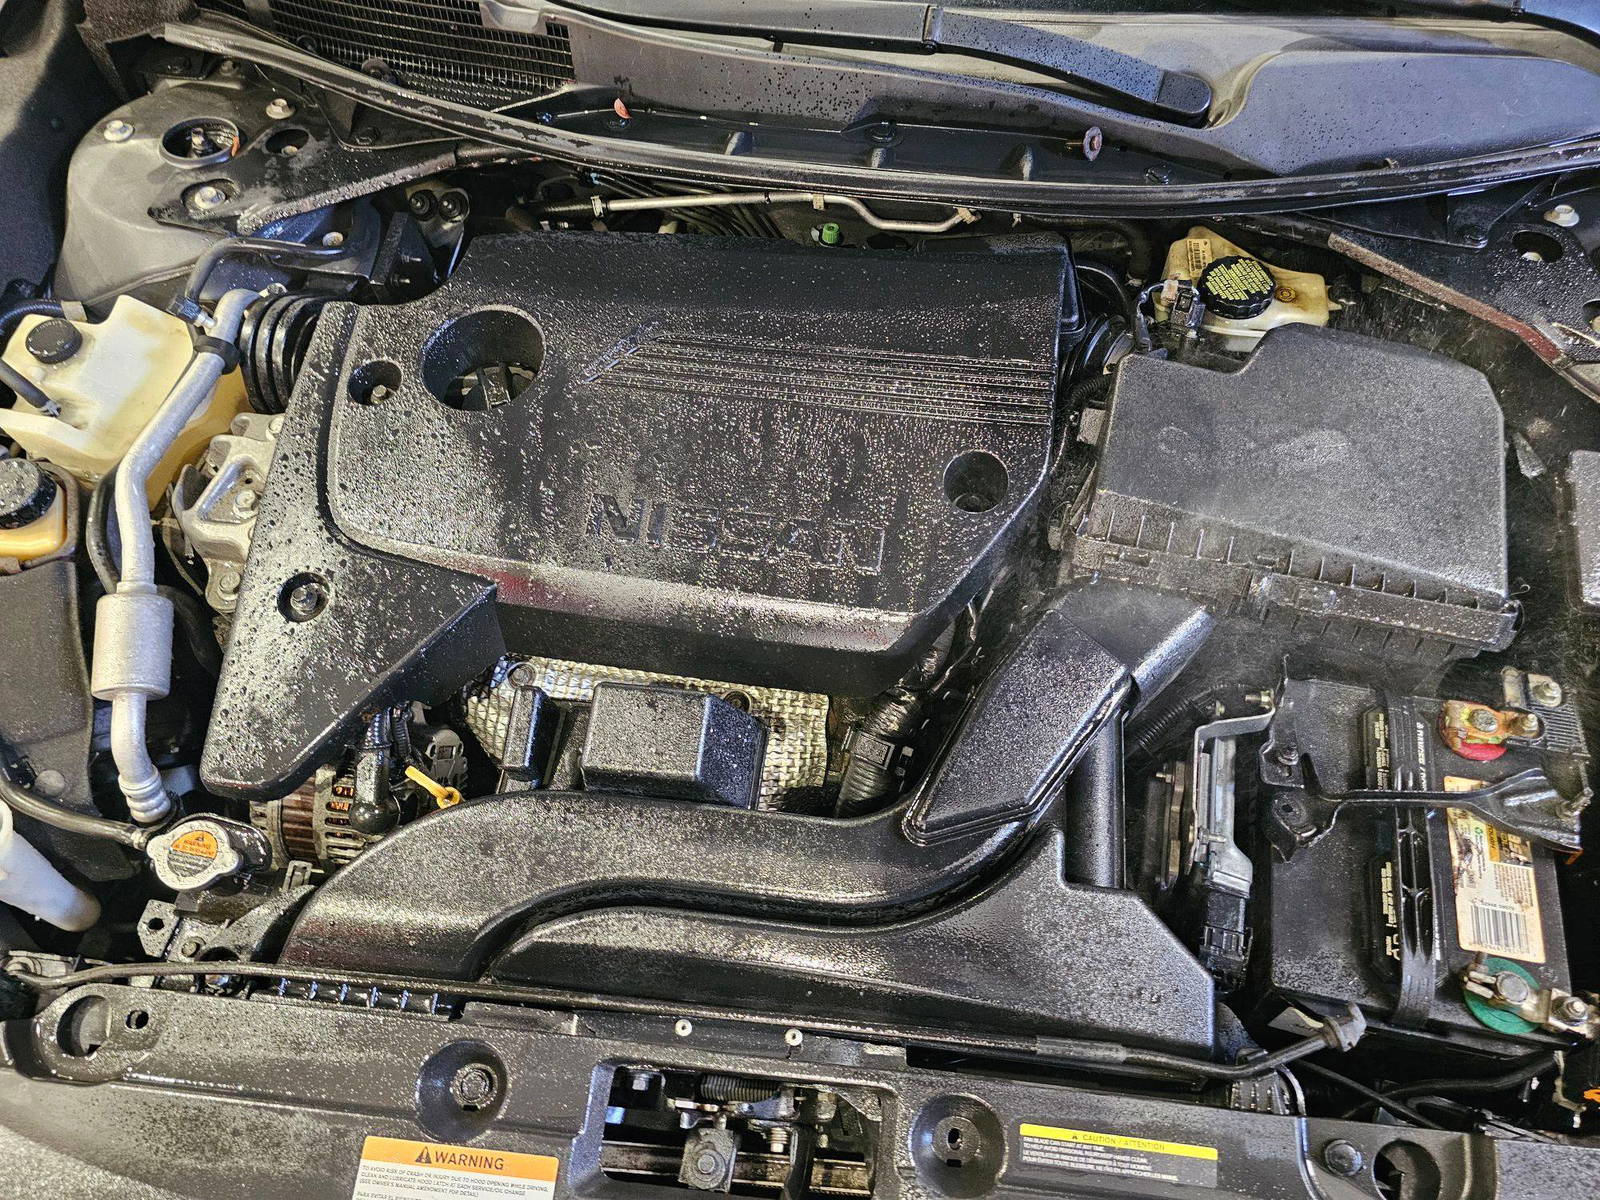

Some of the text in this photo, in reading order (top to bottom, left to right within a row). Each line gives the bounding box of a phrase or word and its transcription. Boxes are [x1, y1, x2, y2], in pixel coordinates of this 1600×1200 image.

[585, 493, 885, 576] NISSAN
[1082, 1134, 1116, 1145] CAUTION
[1124, 1140, 1165, 1151] ATTENTION
[435, 1151, 505, 1170] WARNING
